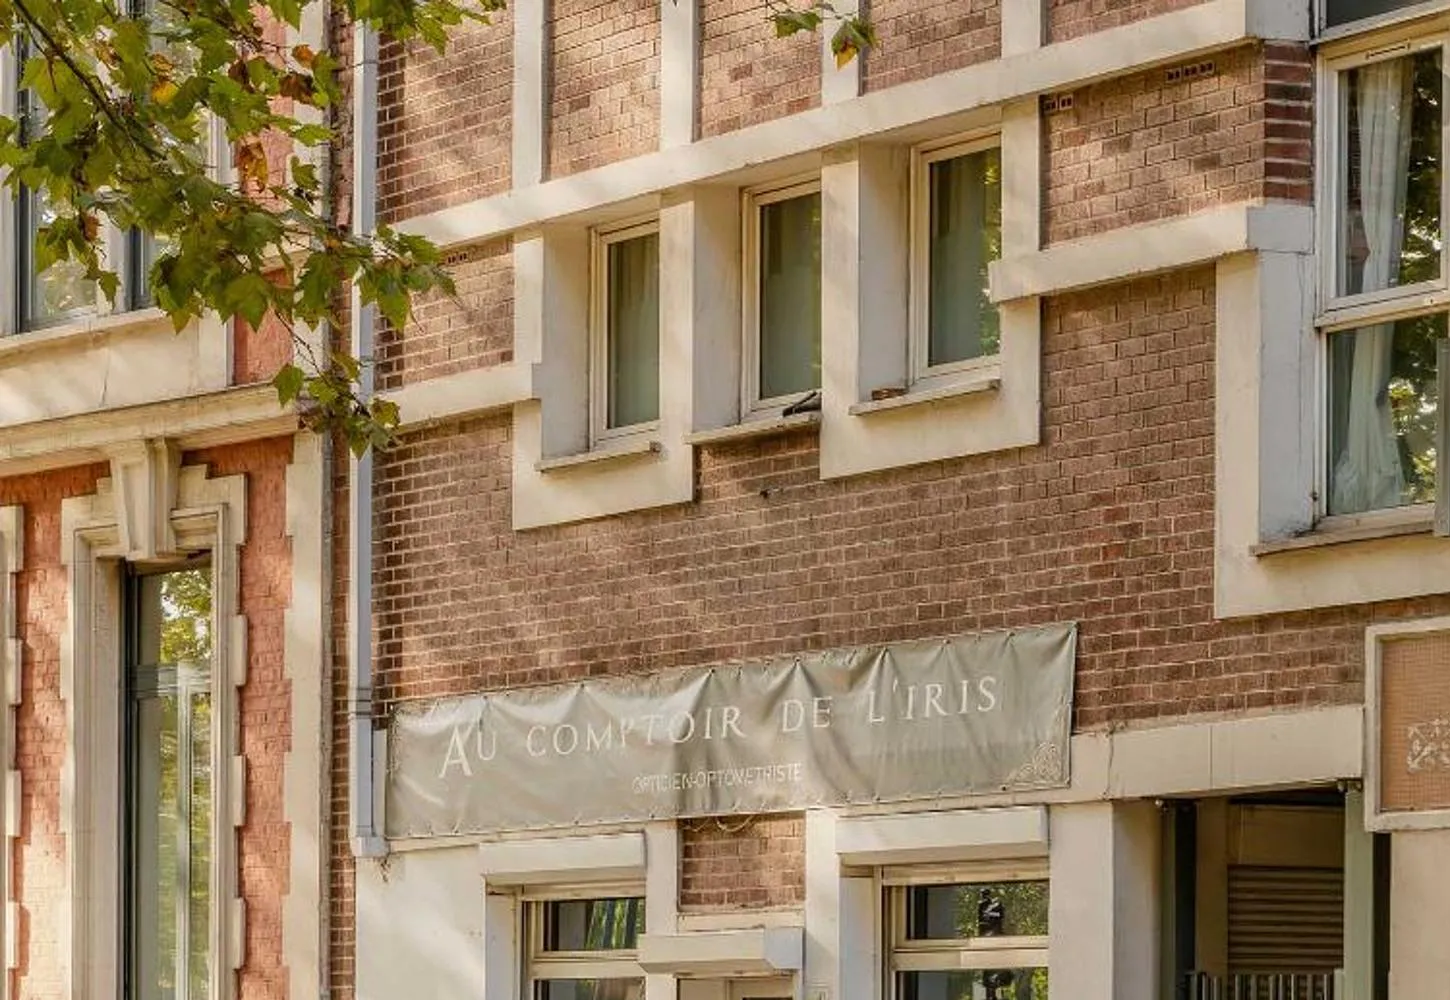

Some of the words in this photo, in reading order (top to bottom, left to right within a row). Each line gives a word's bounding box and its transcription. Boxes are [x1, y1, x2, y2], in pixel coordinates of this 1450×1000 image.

[439, 723, 498, 778] AU
[526, 707, 747, 757] COMPTOIR
[782, 696, 833, 733] DE
[868, 675, 998, 723] L'IRIS
